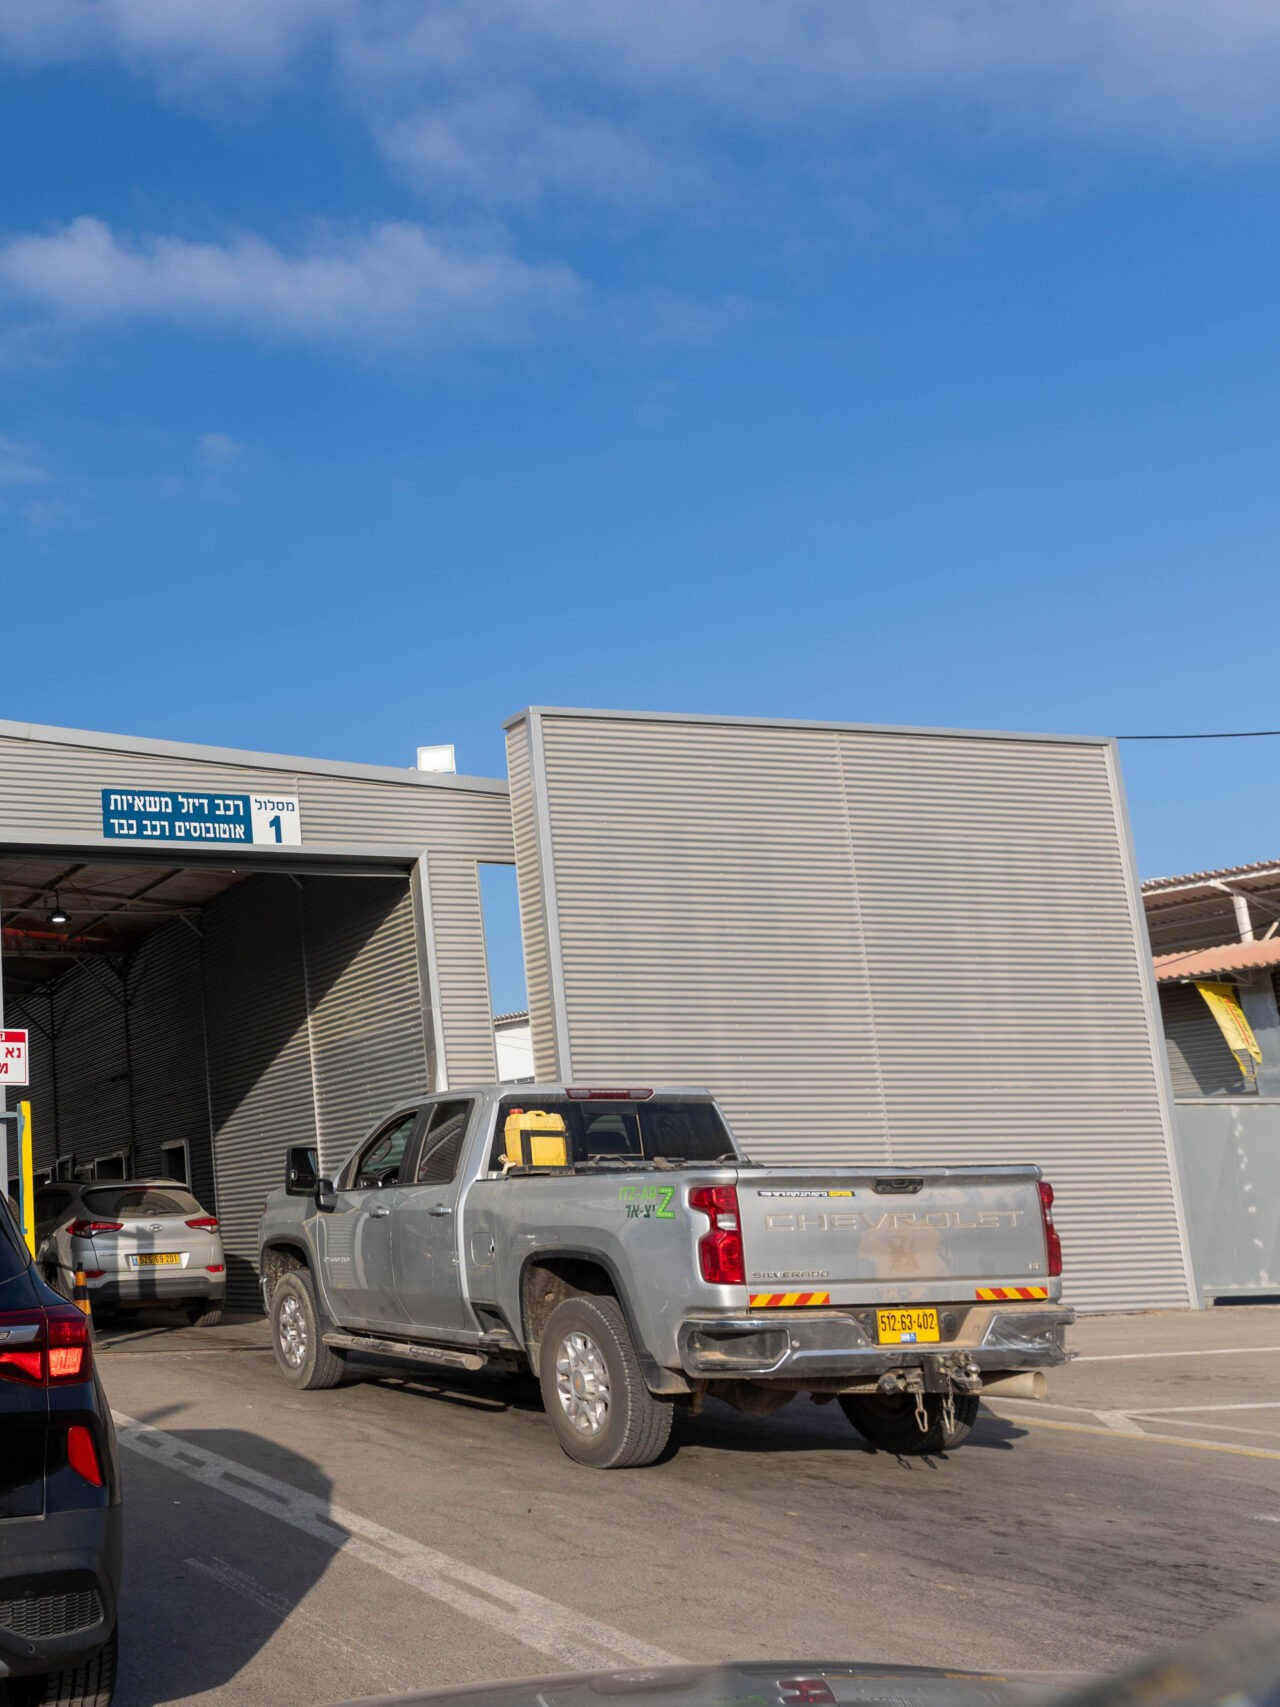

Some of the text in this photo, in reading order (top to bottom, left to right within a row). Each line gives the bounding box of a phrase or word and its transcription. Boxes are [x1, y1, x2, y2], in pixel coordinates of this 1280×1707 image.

[110, 794, 244, 815] רכב דיזל משאיות
[255, 799, 295, 812] מסלול
[110, 818, 246, 839] אוטובוסים רכב כבד
[268, 815, 283, 843] 1
[5, 1047, 21, 1058] נא
[764, 1210, 1024, 1232] CHEVROLET
[751, 1270, 829, 1279] SILVERADO
